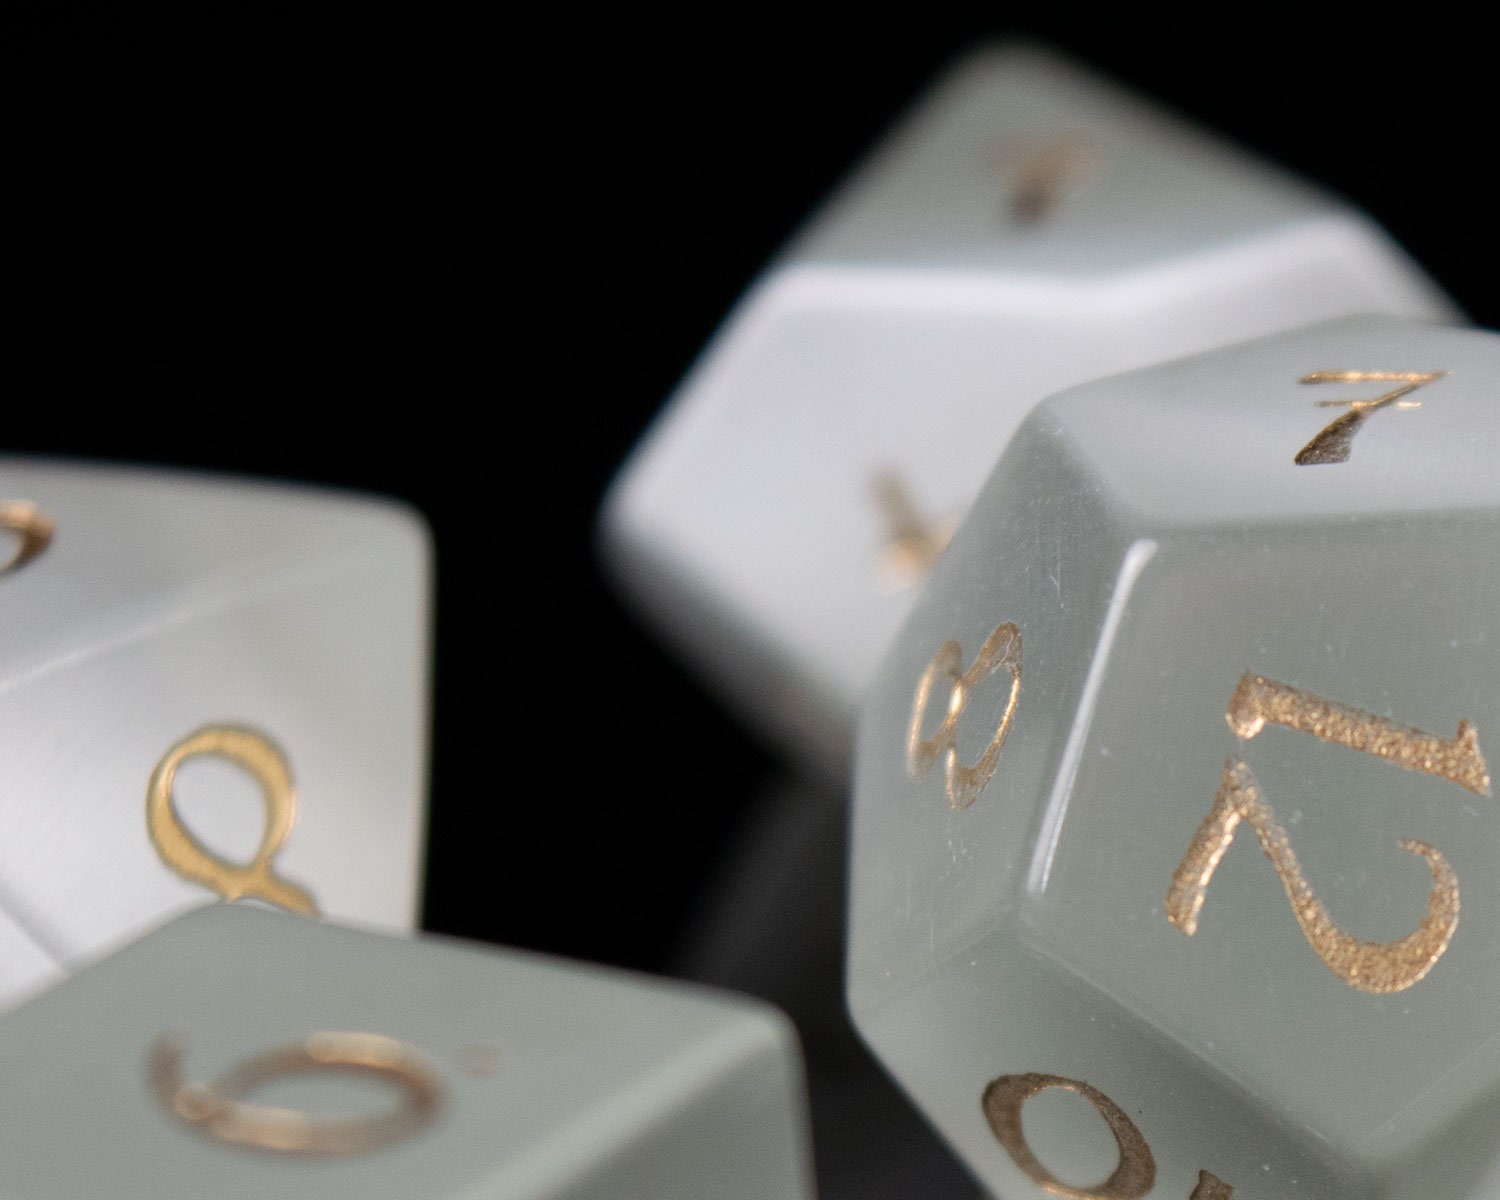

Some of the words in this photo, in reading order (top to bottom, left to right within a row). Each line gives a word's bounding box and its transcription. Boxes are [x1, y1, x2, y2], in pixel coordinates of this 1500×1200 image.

[1293, 369, 1452, 466] 7
[907, 622, 1023, 809] 8
[1164, 669, 1493, 994] 12
